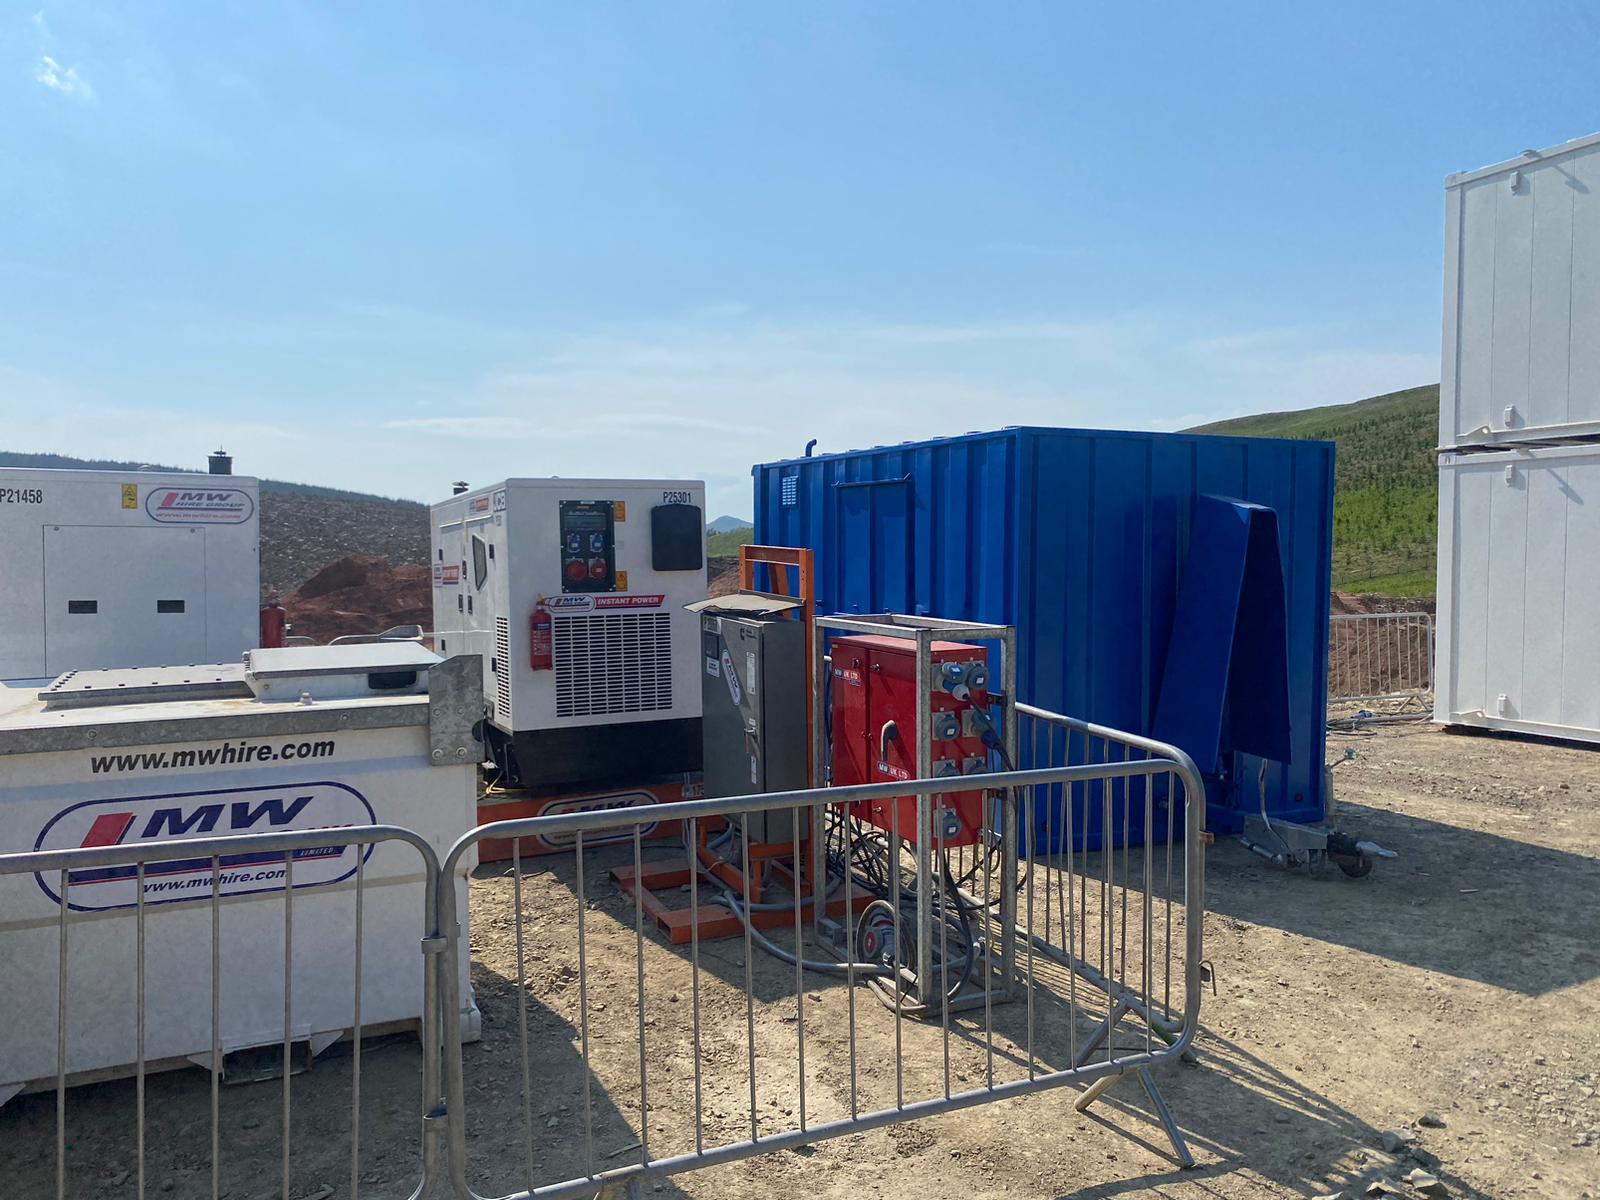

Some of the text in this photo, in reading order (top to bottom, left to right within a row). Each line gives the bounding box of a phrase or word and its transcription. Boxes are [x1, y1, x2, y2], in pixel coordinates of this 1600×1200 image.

[0, 488, 43, 504] P21458
[180, 492, 232, 502] MW
[663, 491, 691, 503] P25301
[631, 596, 659, 604] POWER
[91, 740, 335, 773] www.mwhire.com
[141, 796, 314, 838] MW
[300, 847, 335, 856] LIMITED
